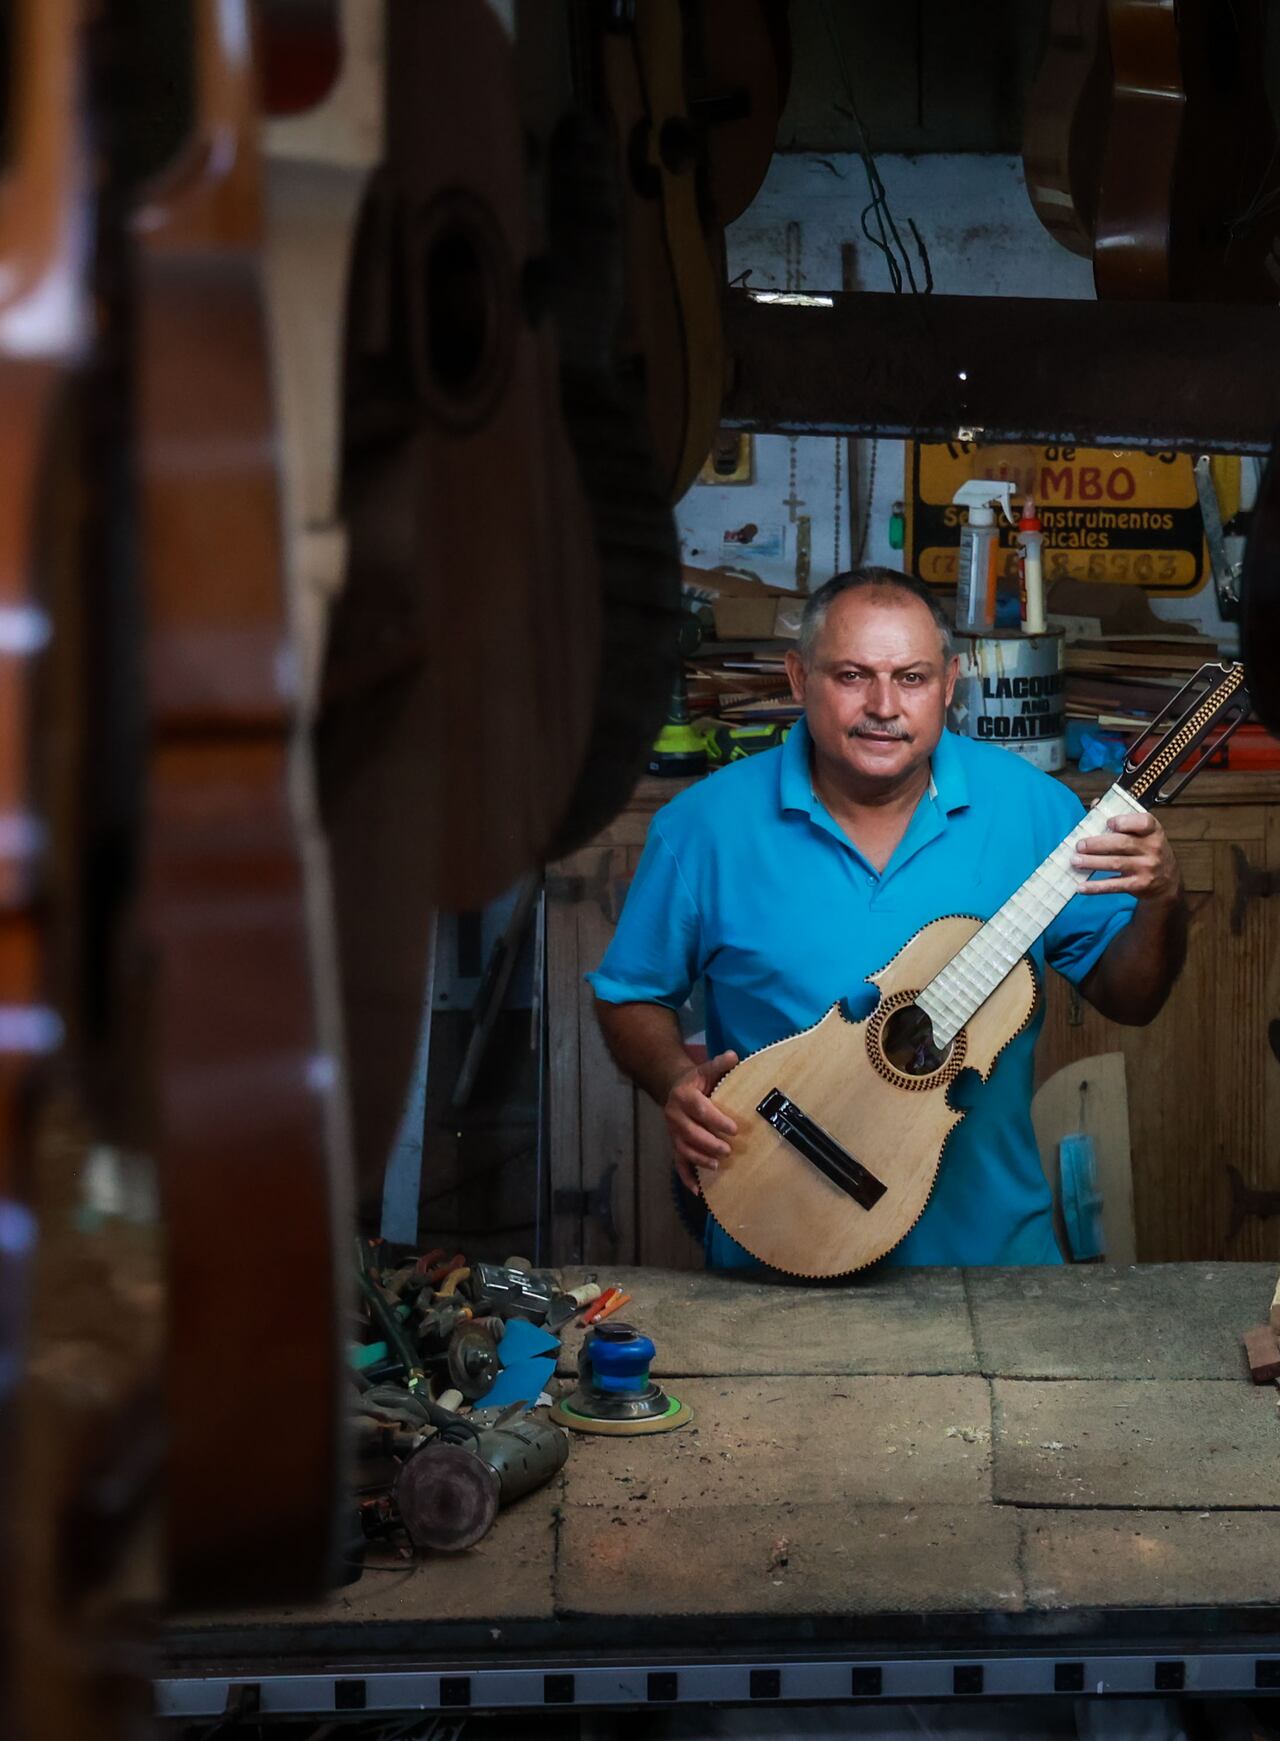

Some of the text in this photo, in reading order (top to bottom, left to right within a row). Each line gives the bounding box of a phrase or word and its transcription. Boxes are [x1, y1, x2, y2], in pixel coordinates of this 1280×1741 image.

[1036, 510, 1175, 530] instrumentos
[1008, 529, 1111, 549] msicales
[983, 675, 1063, 700] LACQU
